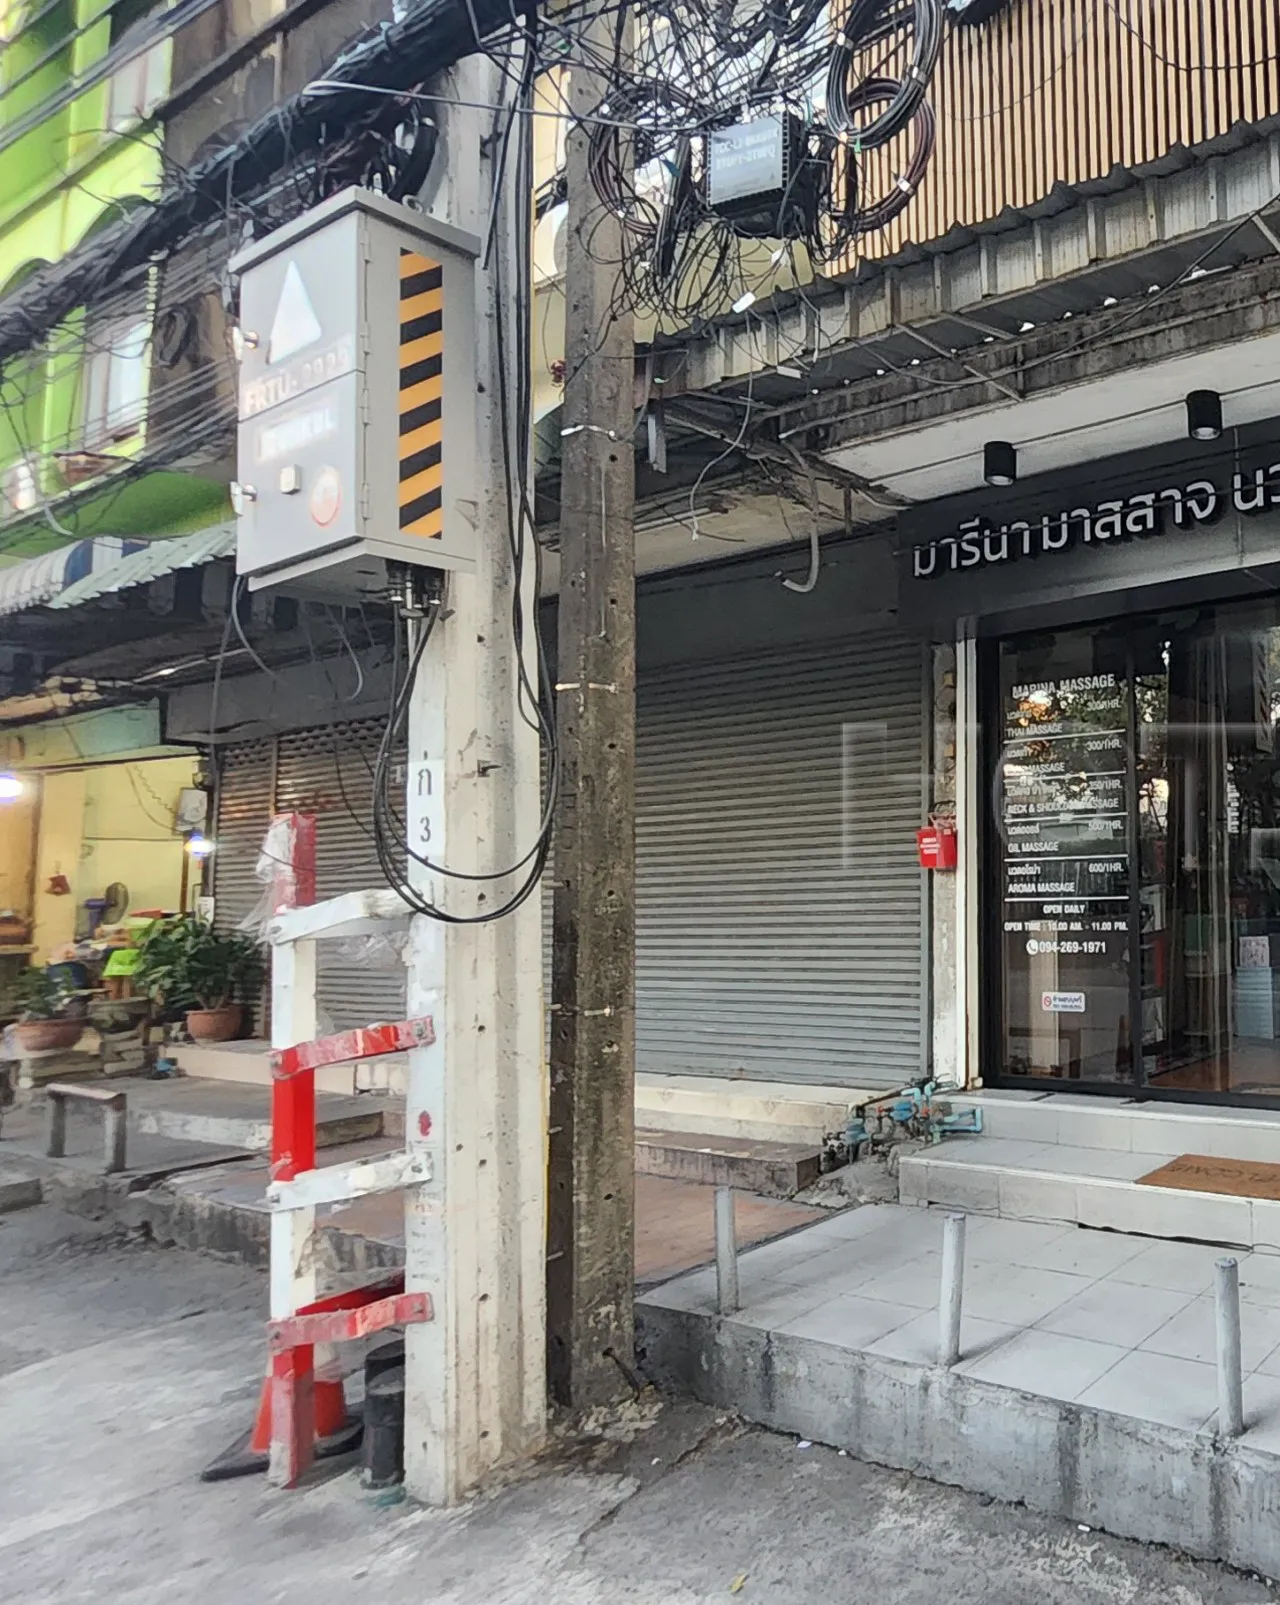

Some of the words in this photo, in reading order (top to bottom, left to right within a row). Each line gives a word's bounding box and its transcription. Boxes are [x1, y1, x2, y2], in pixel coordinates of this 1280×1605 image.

[912, 515, 1030, 577] มารีนา
[1041, 480, 1218, 551] มาสสาจ
[1011, 681, 1057, 700] MARINA
[1059, 673, 1116, 693] MASSAGE
[1026, 723, 1064, 736] MASSAGE
[417, 768, 432, 796] ก
[1007, 803, 1028, 815] NECK
[1029, 803, 1036, 814] &
[419, 816, 432, 842] 3
[1007, 842, 1021, 854] OIL
[1021, 840, 1060, 853] MASSAGE
[1007, 882, 1037, 893] AROMA
[1037, 882, 1076, 892] MASSAGE
[1043, 904, 1062, 914] OPEN
[1064, 903, 1085, 914] DAILY
[1004, 921, 1023, 932] OPEN
[1024, 921, 1041, 931] TIME
[1091, 921, 1112, 931] 11.00
[1038, 940, 1107, 954] 094-269-1971
